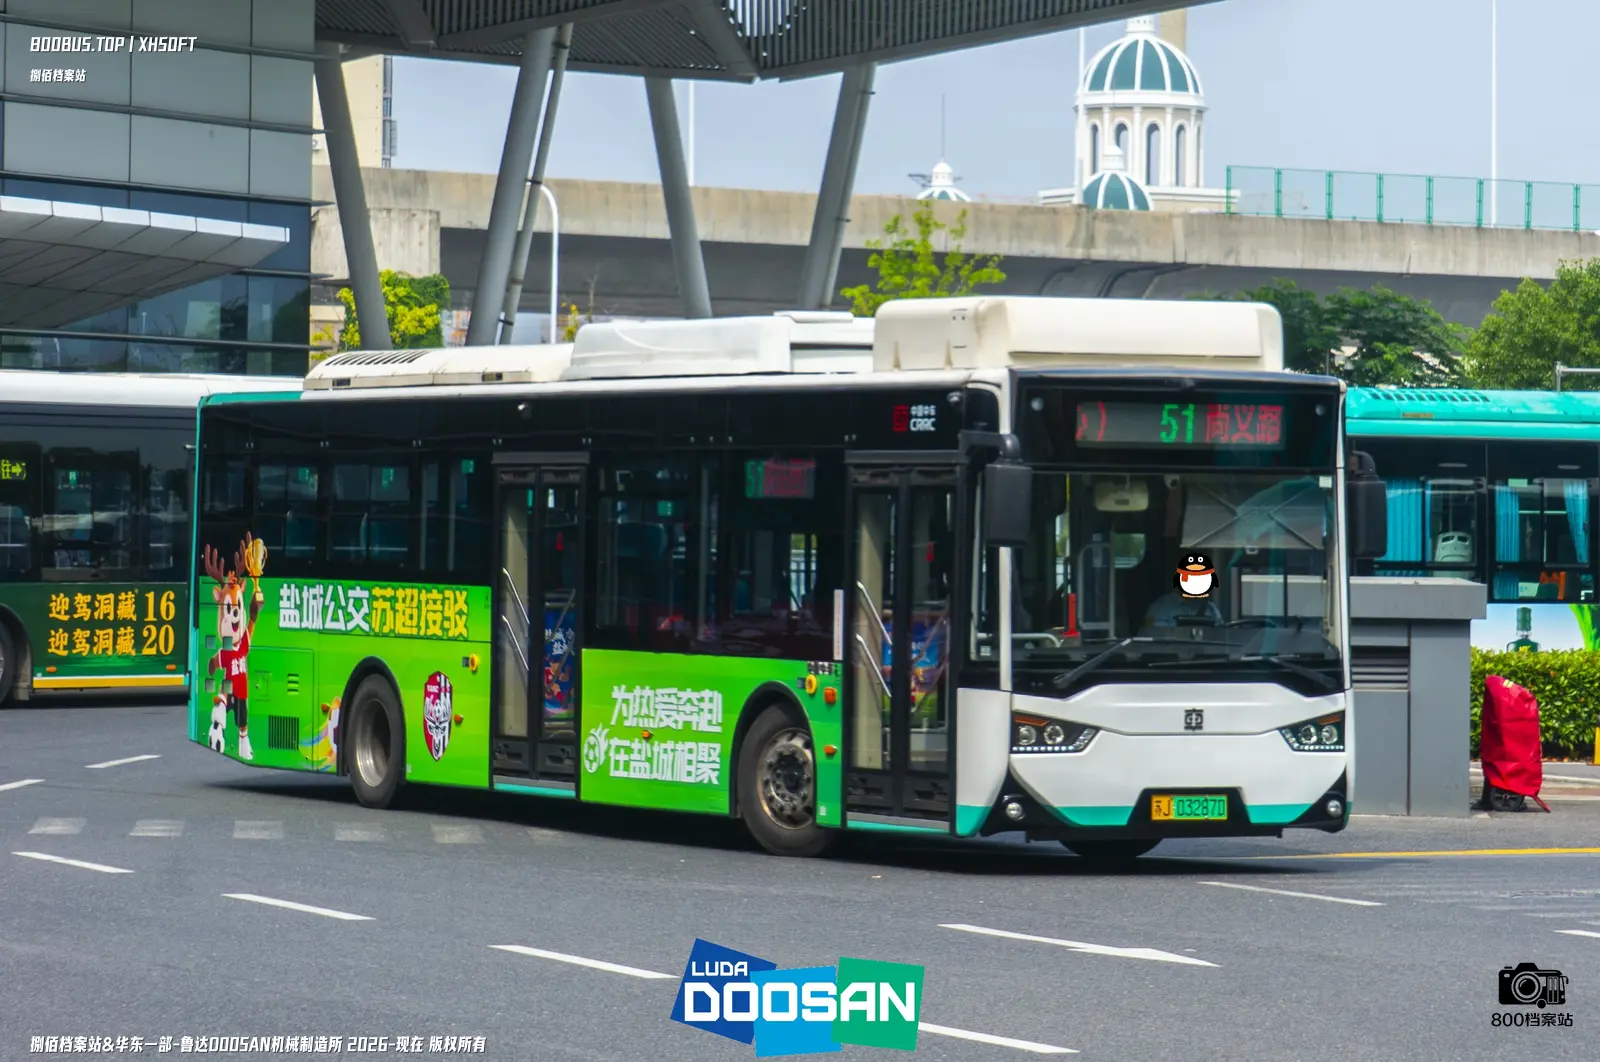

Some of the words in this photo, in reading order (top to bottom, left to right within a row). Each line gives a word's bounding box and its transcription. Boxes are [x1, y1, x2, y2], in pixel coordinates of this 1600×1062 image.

[1159, 403, 1196, 443] 51
[48, 591, 137, 621] 迎驾洞藏
[144, 590, 176, 621] 16
[278, 583, 469, 638] 盐城公交苏超接驳
[47, 626, 137, 656] 迎驾洞藏
[141, 624, 175, 655] 20
[610, 684, 723, 733] 为热爱奔赴
[608, 736, 722, 785] 在盐城相聚
